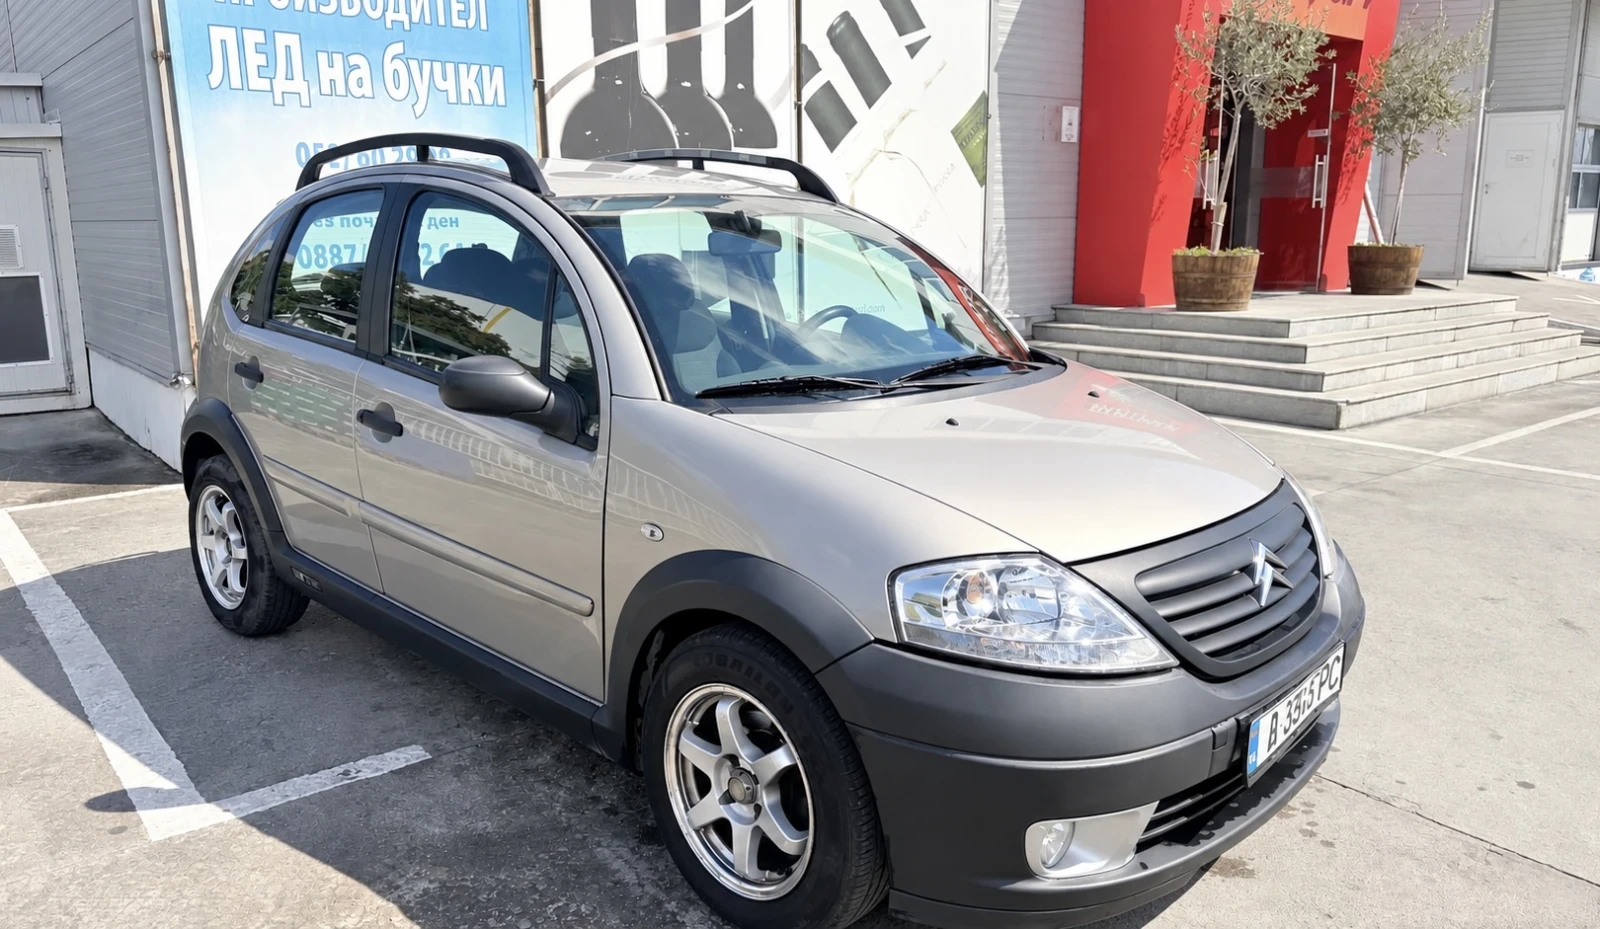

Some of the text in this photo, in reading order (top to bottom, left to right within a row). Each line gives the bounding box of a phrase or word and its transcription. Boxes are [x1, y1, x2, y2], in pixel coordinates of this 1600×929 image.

[206, 23, 507, 119] ЛЕД на бучки
[427, 216, 459, 230] ден
